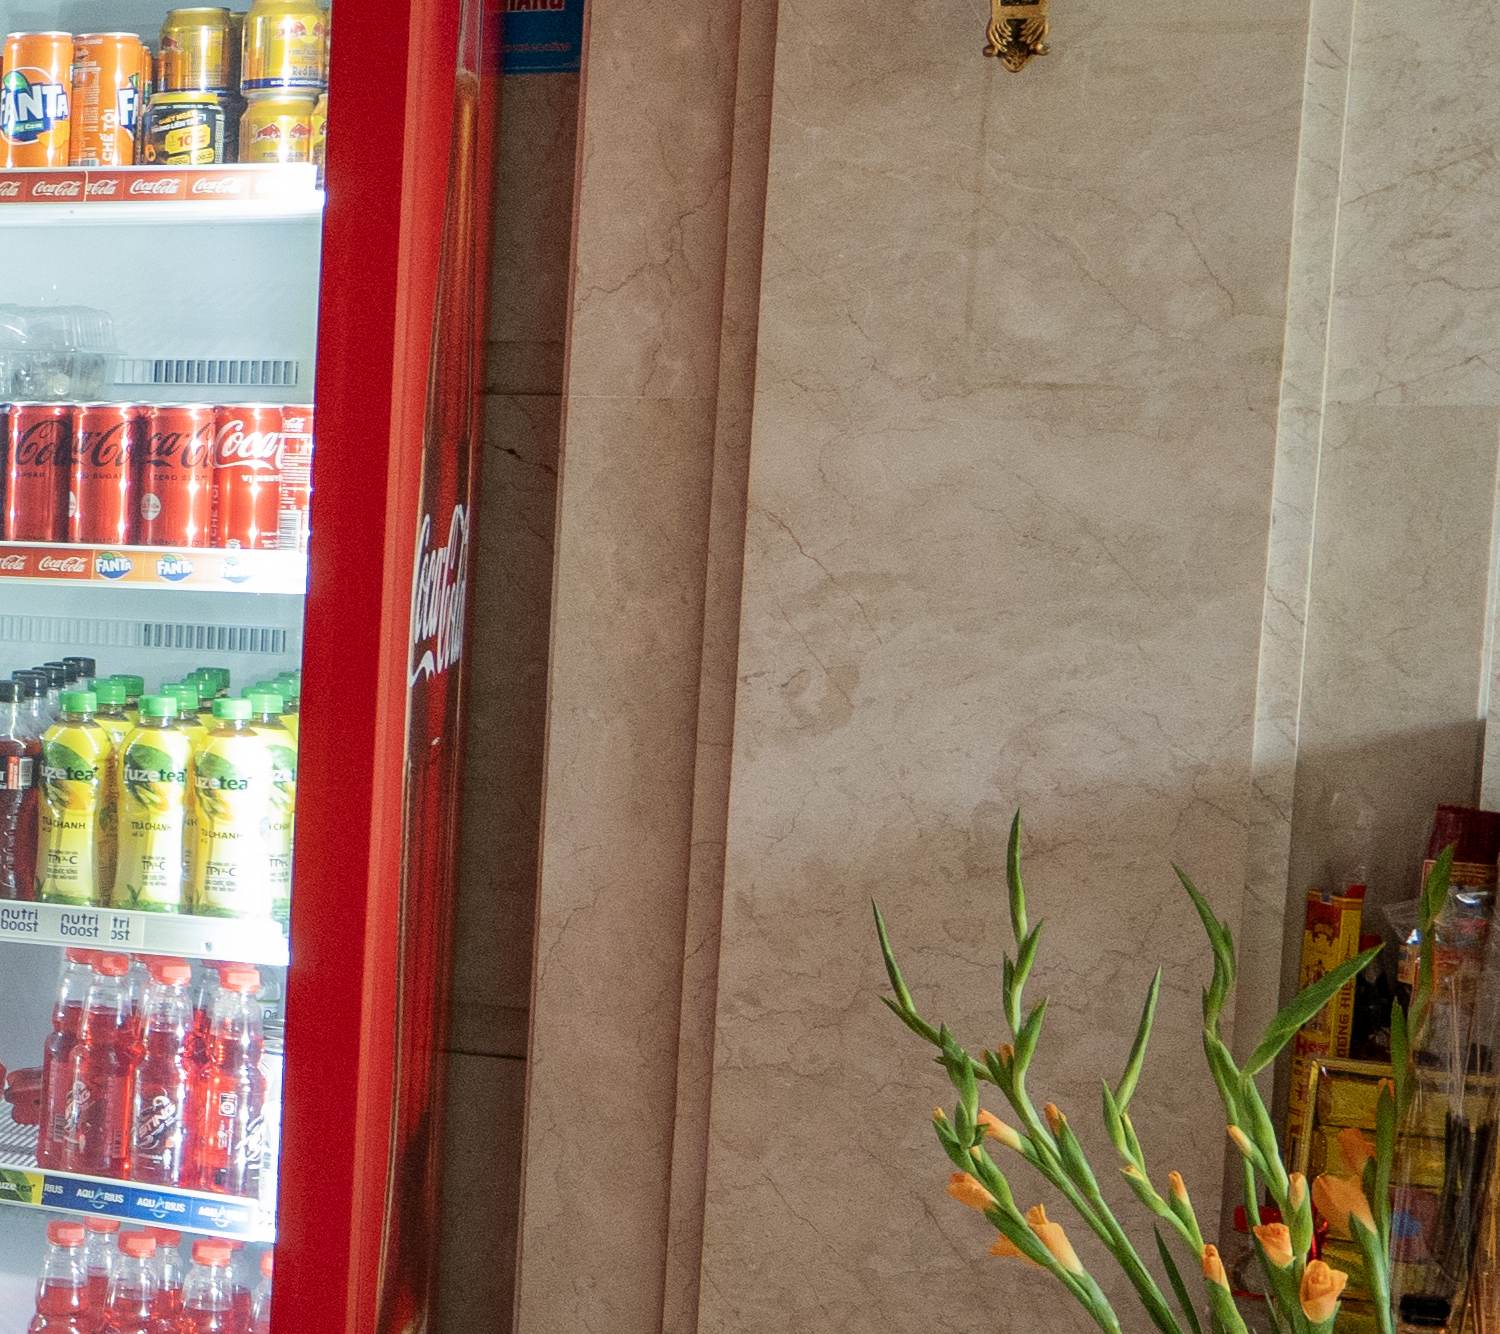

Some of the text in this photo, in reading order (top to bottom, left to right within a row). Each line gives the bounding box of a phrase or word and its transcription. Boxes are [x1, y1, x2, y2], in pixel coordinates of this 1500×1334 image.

[0, 83, 69, 124] FANTA
[103, 108, 114, 162] CHẾ TÔI
[32, 180, 80, 197] Coca-Cola
[129, 178, 179, 195] Coca-Cola
[38, 554, 87, 573] Coca-Cola
[95, 556, 132, 573] FANTA
[155, 558, 194, 576] FANTA
[123, 766, 187, 783] fuzetea
[0, 908, 39, 921] nutri
[60, 912, 100, 925] nutri
[0, 917, 39, 933] boost
[60, 922, 100, 938] boost
[76, 1187, 125, 1205] AQUARIUS
[136, 1195, 186, 1214] AQUARIUS
